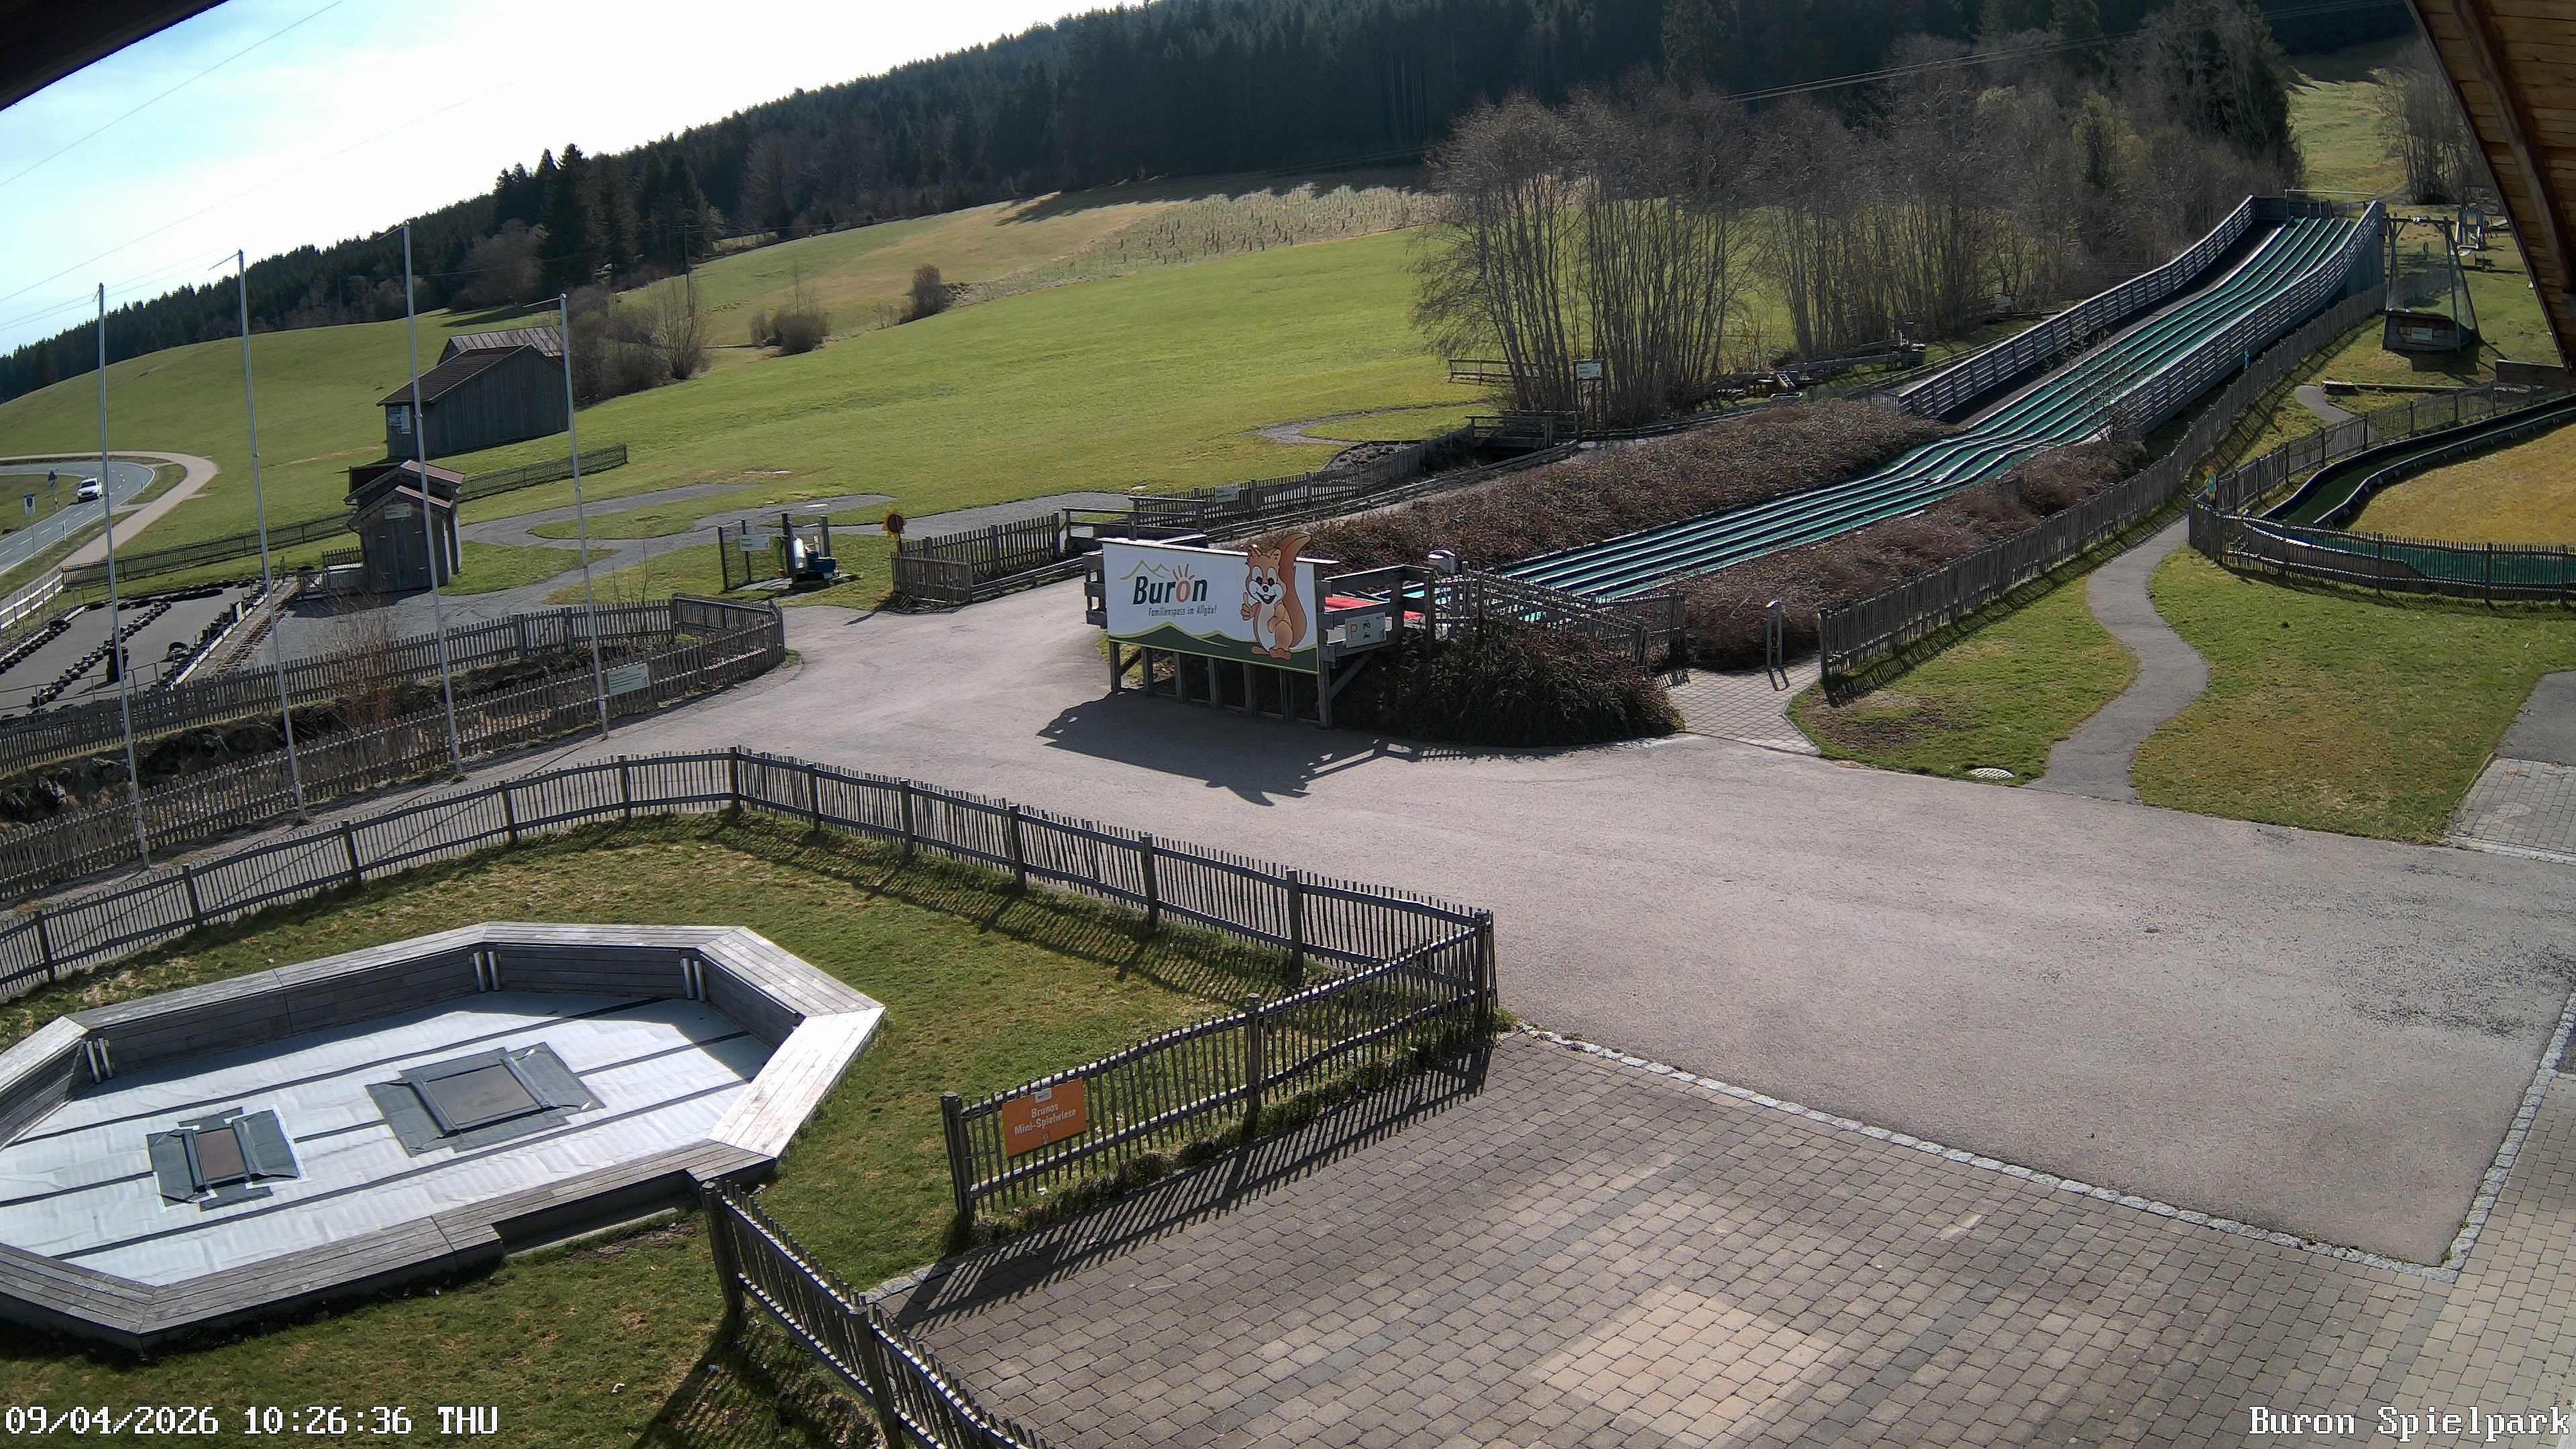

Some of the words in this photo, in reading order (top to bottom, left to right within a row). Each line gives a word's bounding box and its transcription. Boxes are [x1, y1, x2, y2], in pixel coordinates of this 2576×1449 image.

[1132, 576, 1208, 604] Buron
[1014, 1109, 1077, 1135] Mini-Spielwiese
[1030, 1104, 1059, 1118] Brunos
